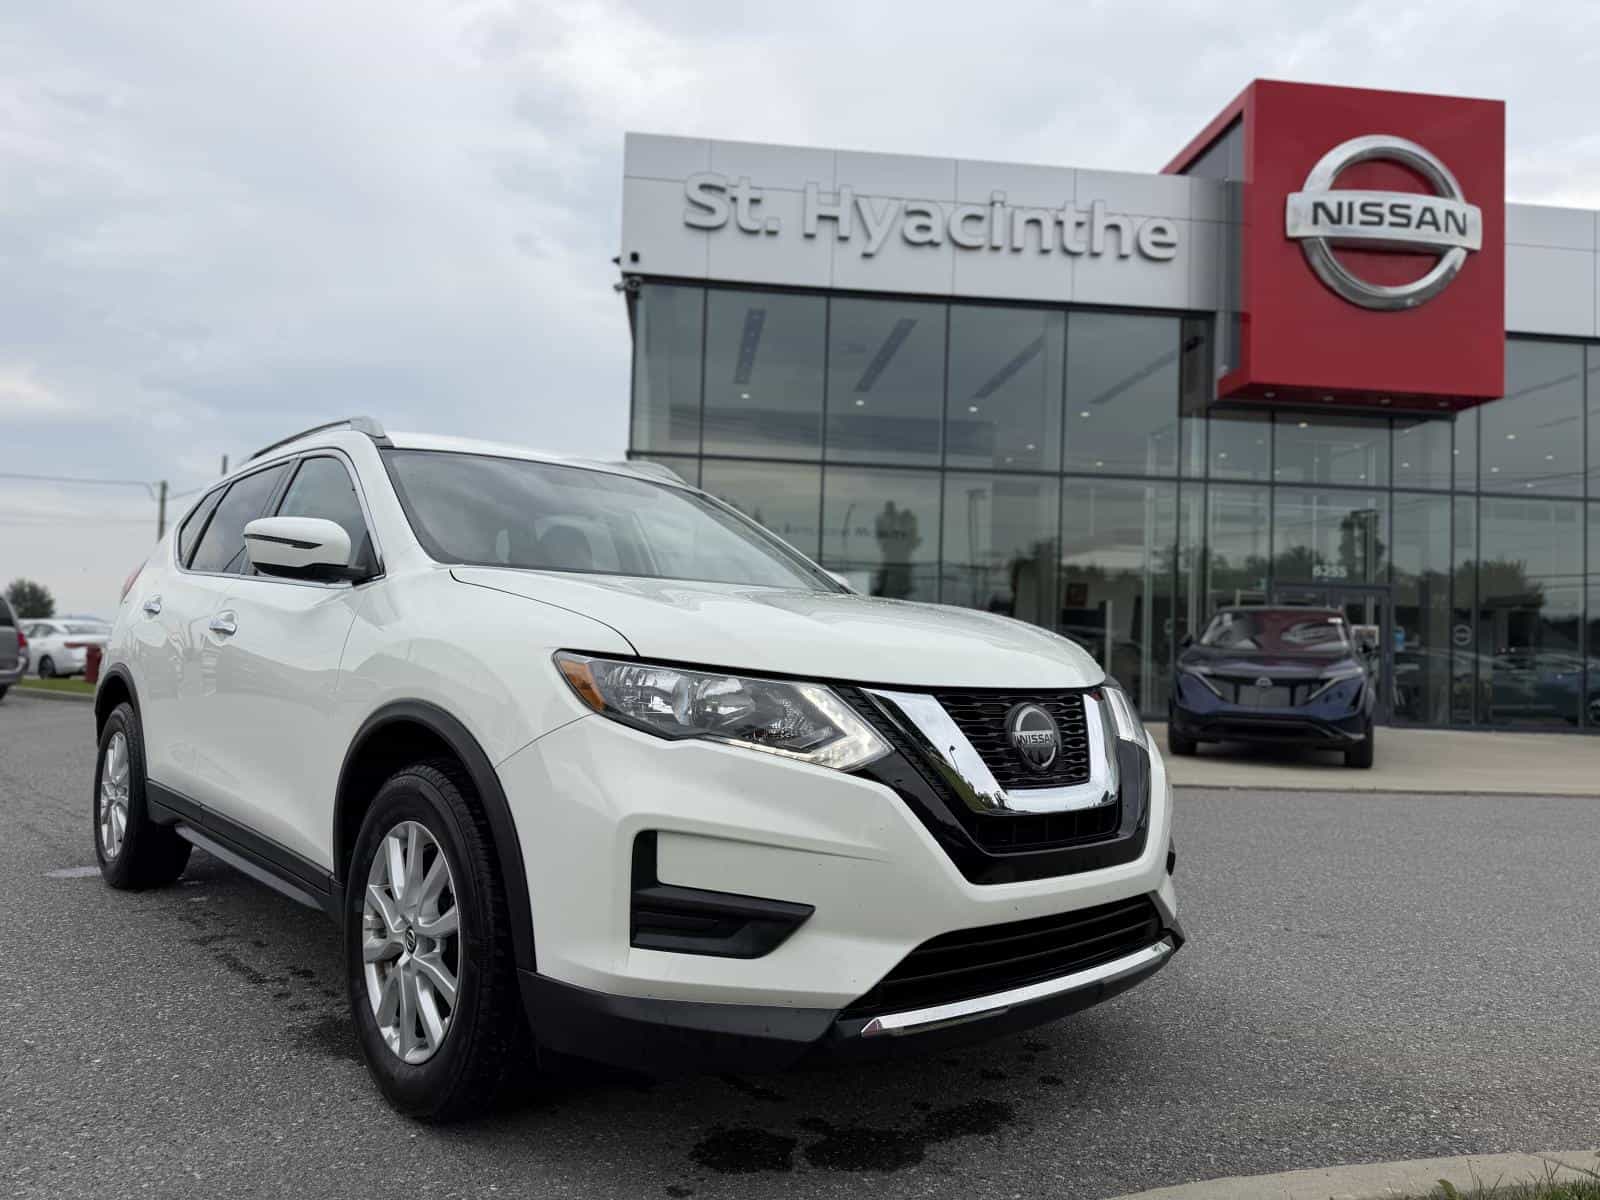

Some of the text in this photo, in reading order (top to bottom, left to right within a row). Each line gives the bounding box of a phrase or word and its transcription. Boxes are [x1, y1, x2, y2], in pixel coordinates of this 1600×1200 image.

[683, 173, 1178, 261] St. Hyacinthe
[1312, 201, 1467, 237] NISSAN
